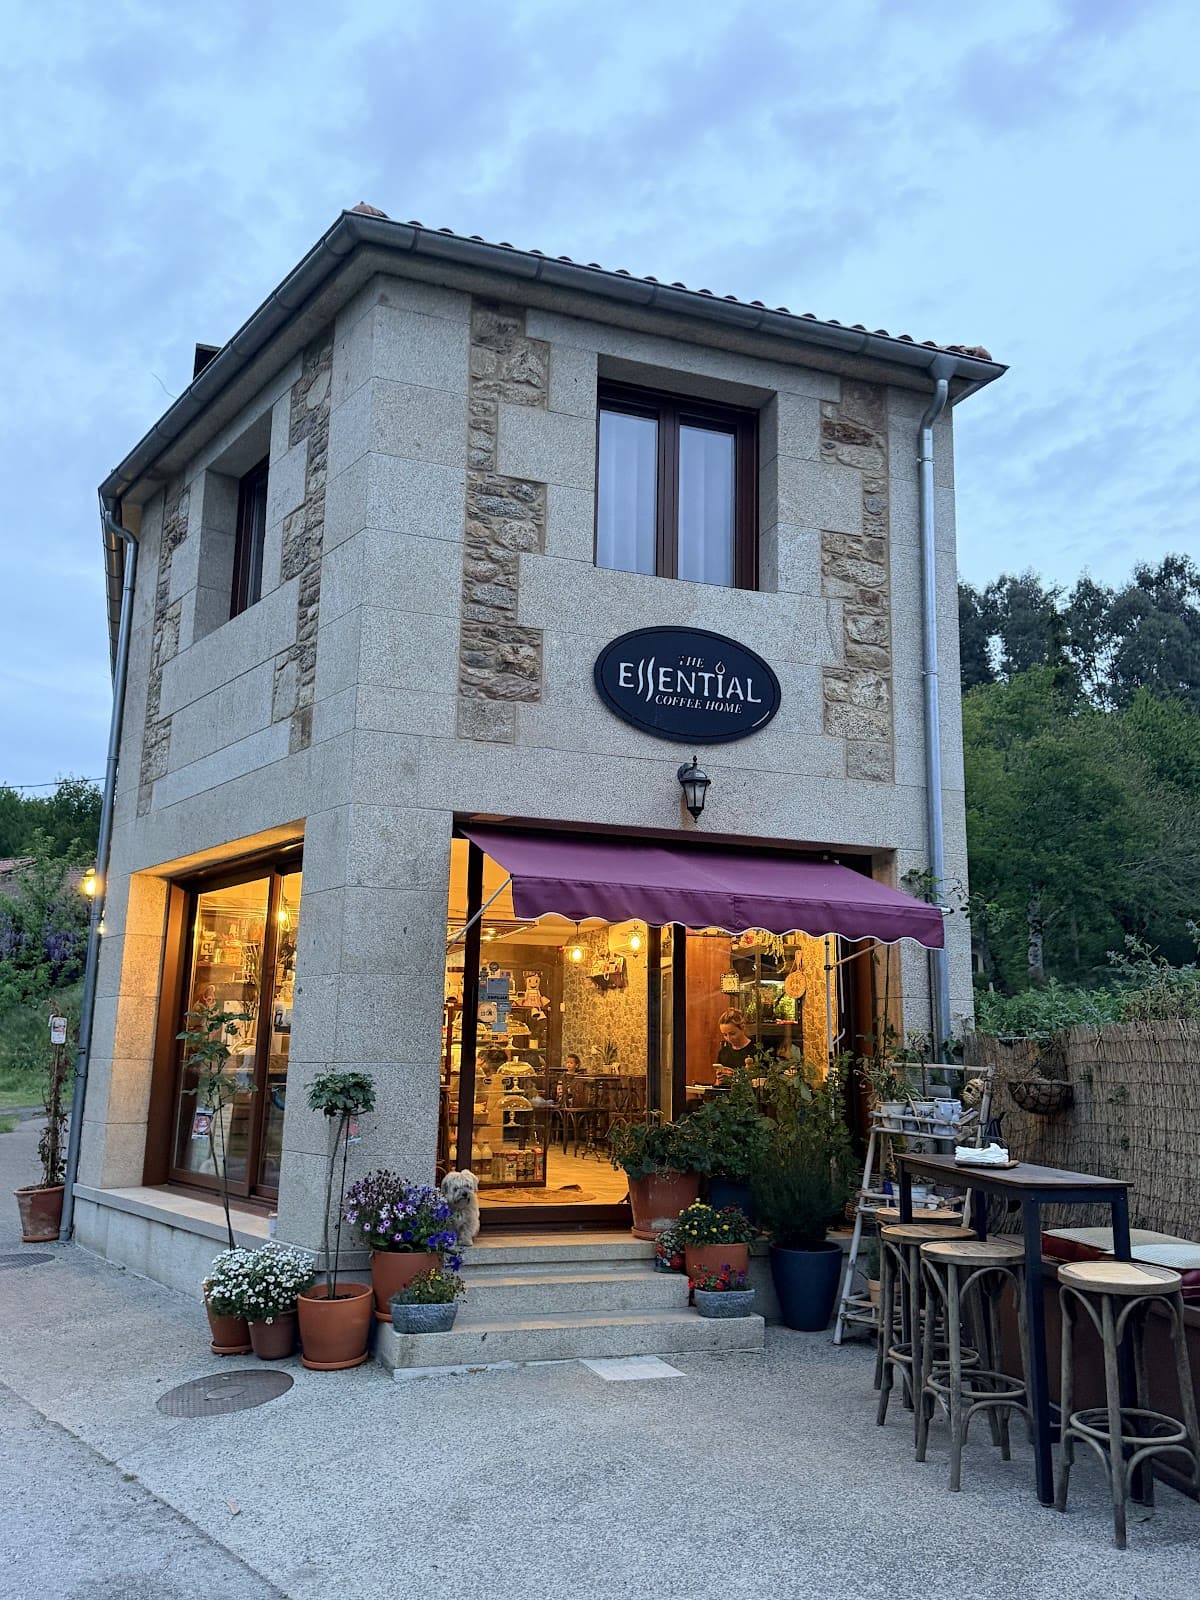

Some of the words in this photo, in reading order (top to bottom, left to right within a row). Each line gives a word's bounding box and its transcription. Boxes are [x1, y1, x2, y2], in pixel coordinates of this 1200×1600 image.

[618, 656, 762, 703] ESSENTIAL
[655, 694, 702, 709] COFFEE
[705, 701, 743, 714] HOME
